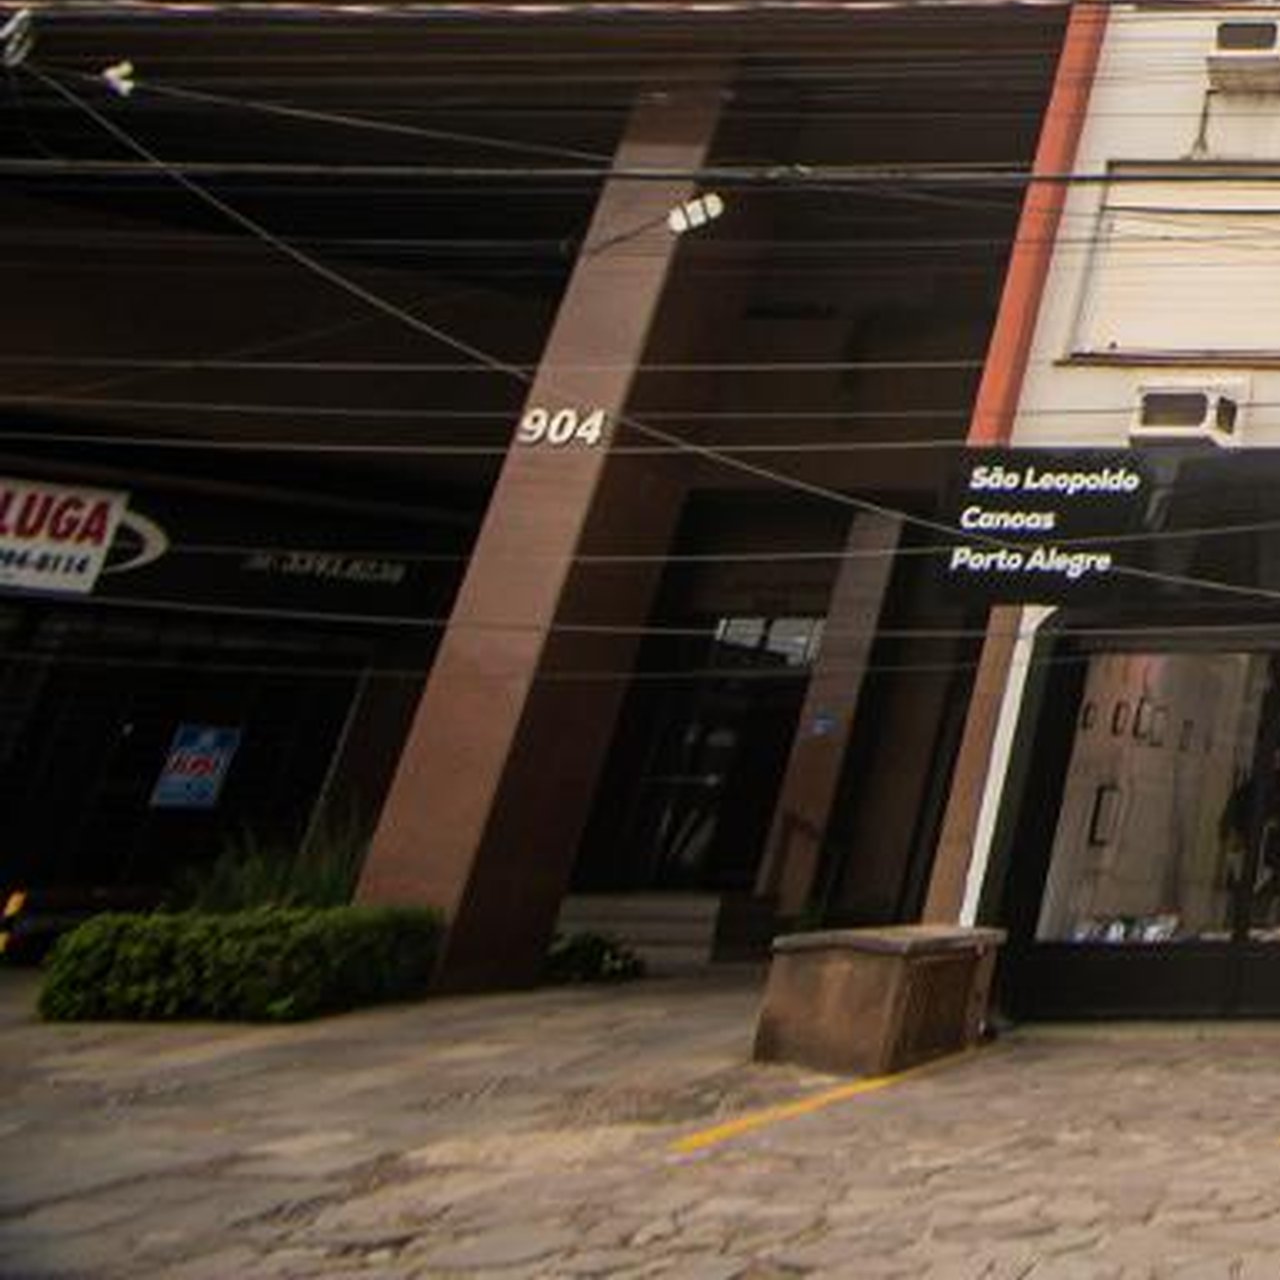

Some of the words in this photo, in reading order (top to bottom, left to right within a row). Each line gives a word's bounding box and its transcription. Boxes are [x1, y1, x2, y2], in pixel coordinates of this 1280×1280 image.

[515, 409, 605, 445] 904
[969, 465, 1020, 490] São
[1023, 465, 1140, 495] Leopoldo
[960, 506, 1056, 530] Canoas
[950, 547, 1022, 570] Porto
[1023, 546, 1113, 579] Alegre
